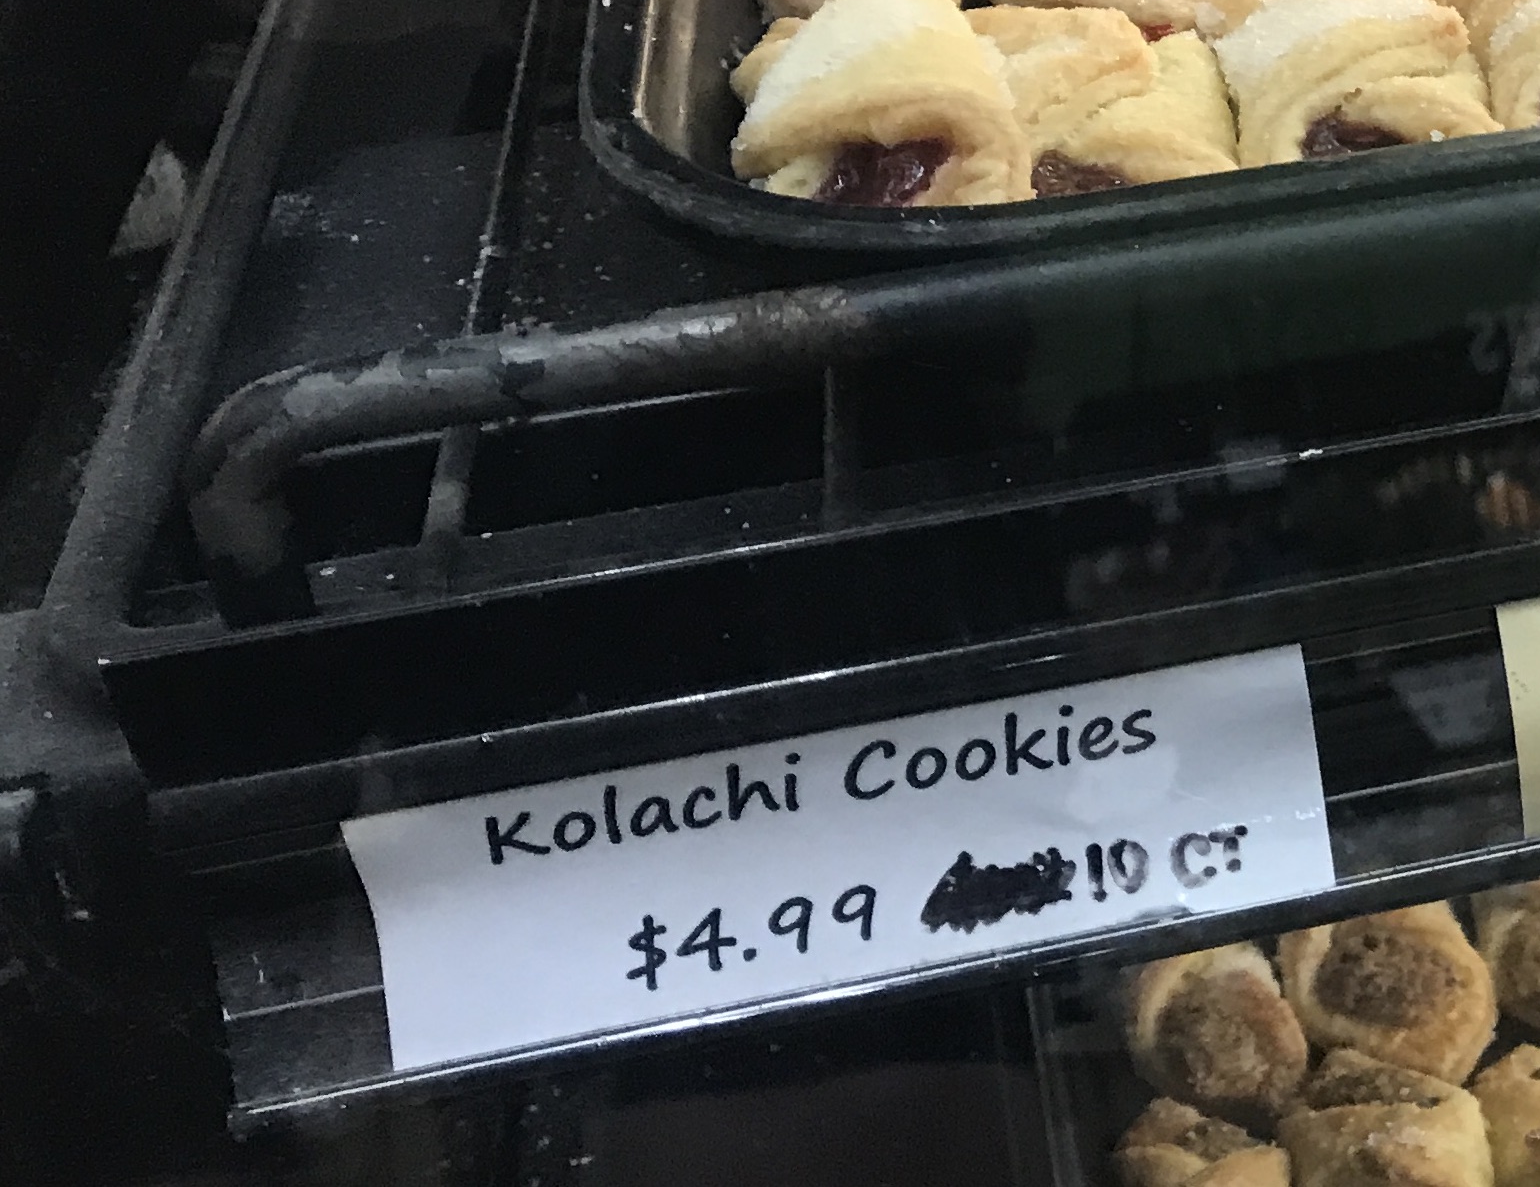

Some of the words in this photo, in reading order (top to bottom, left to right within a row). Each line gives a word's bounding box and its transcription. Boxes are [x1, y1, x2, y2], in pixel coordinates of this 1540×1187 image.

[484, 751, 802, 866] Kolachi
[843, 704, 1157, 801] Cookies
[625, 884, 878, 993] $4.99
[1084, 838, 1150, 903] 10
[1169, 824, 1249, 890] CT
